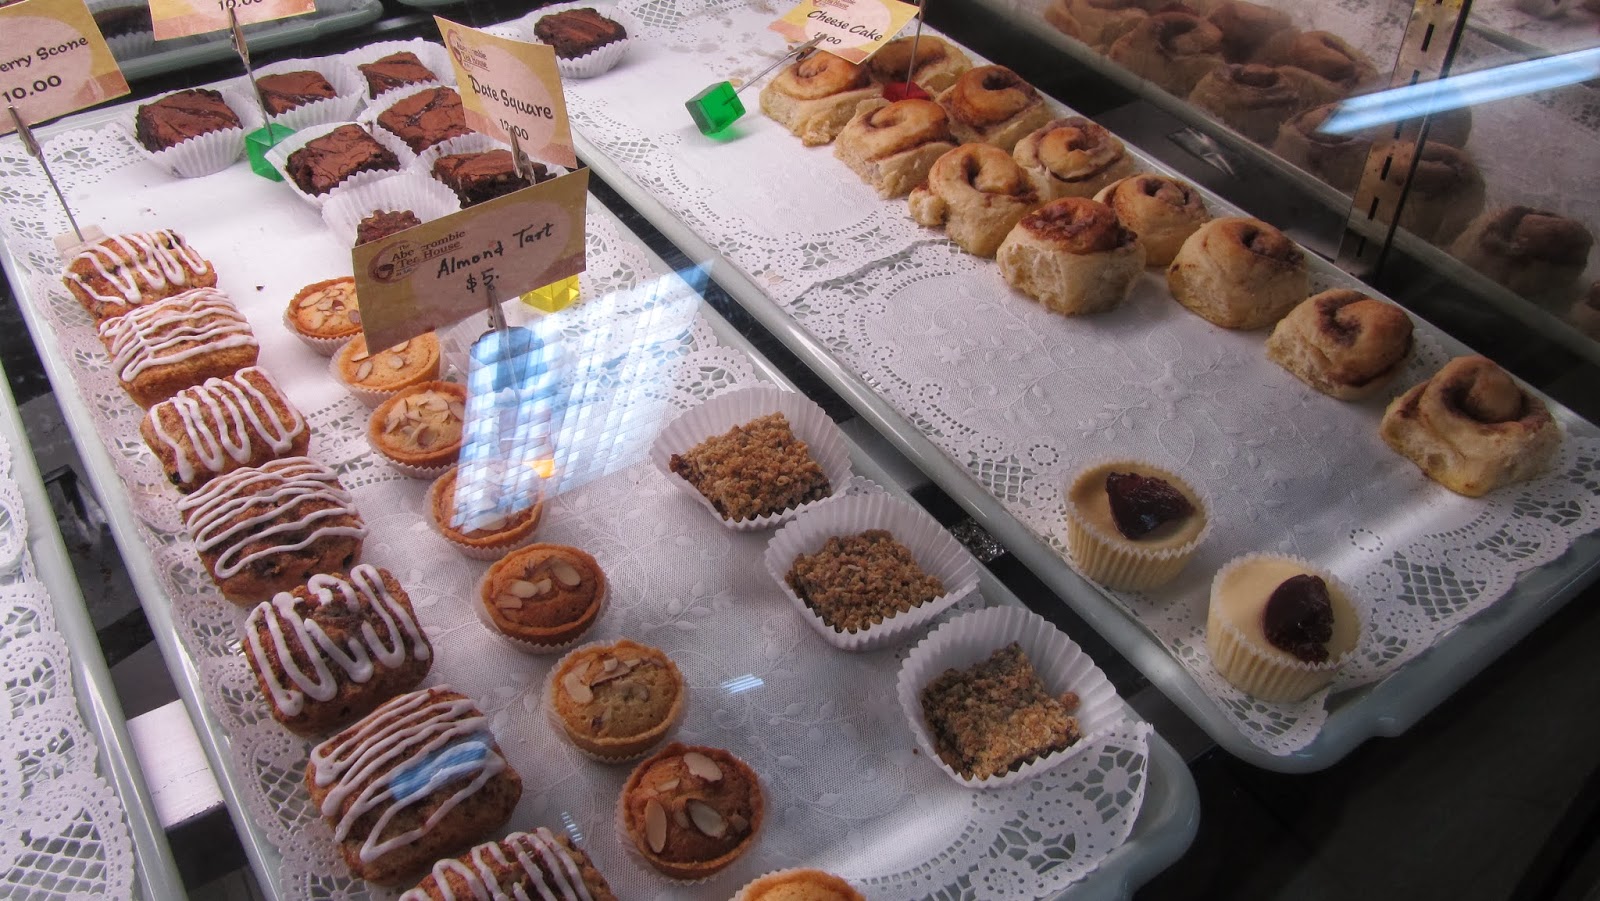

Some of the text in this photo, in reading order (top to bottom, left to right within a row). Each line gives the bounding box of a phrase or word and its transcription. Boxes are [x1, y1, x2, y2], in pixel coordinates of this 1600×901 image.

[218, 0, 263, 10] 10.
[807, 10, 883, 41] Cheese Cake
[36, 37, 89, 60] Scone
[2, 75, 62, 103] 10.00
[467, 74, 554, 119] Date Square
[423, 241, 461, 260] House
[436, 222, 554, 279] Almond Tart
